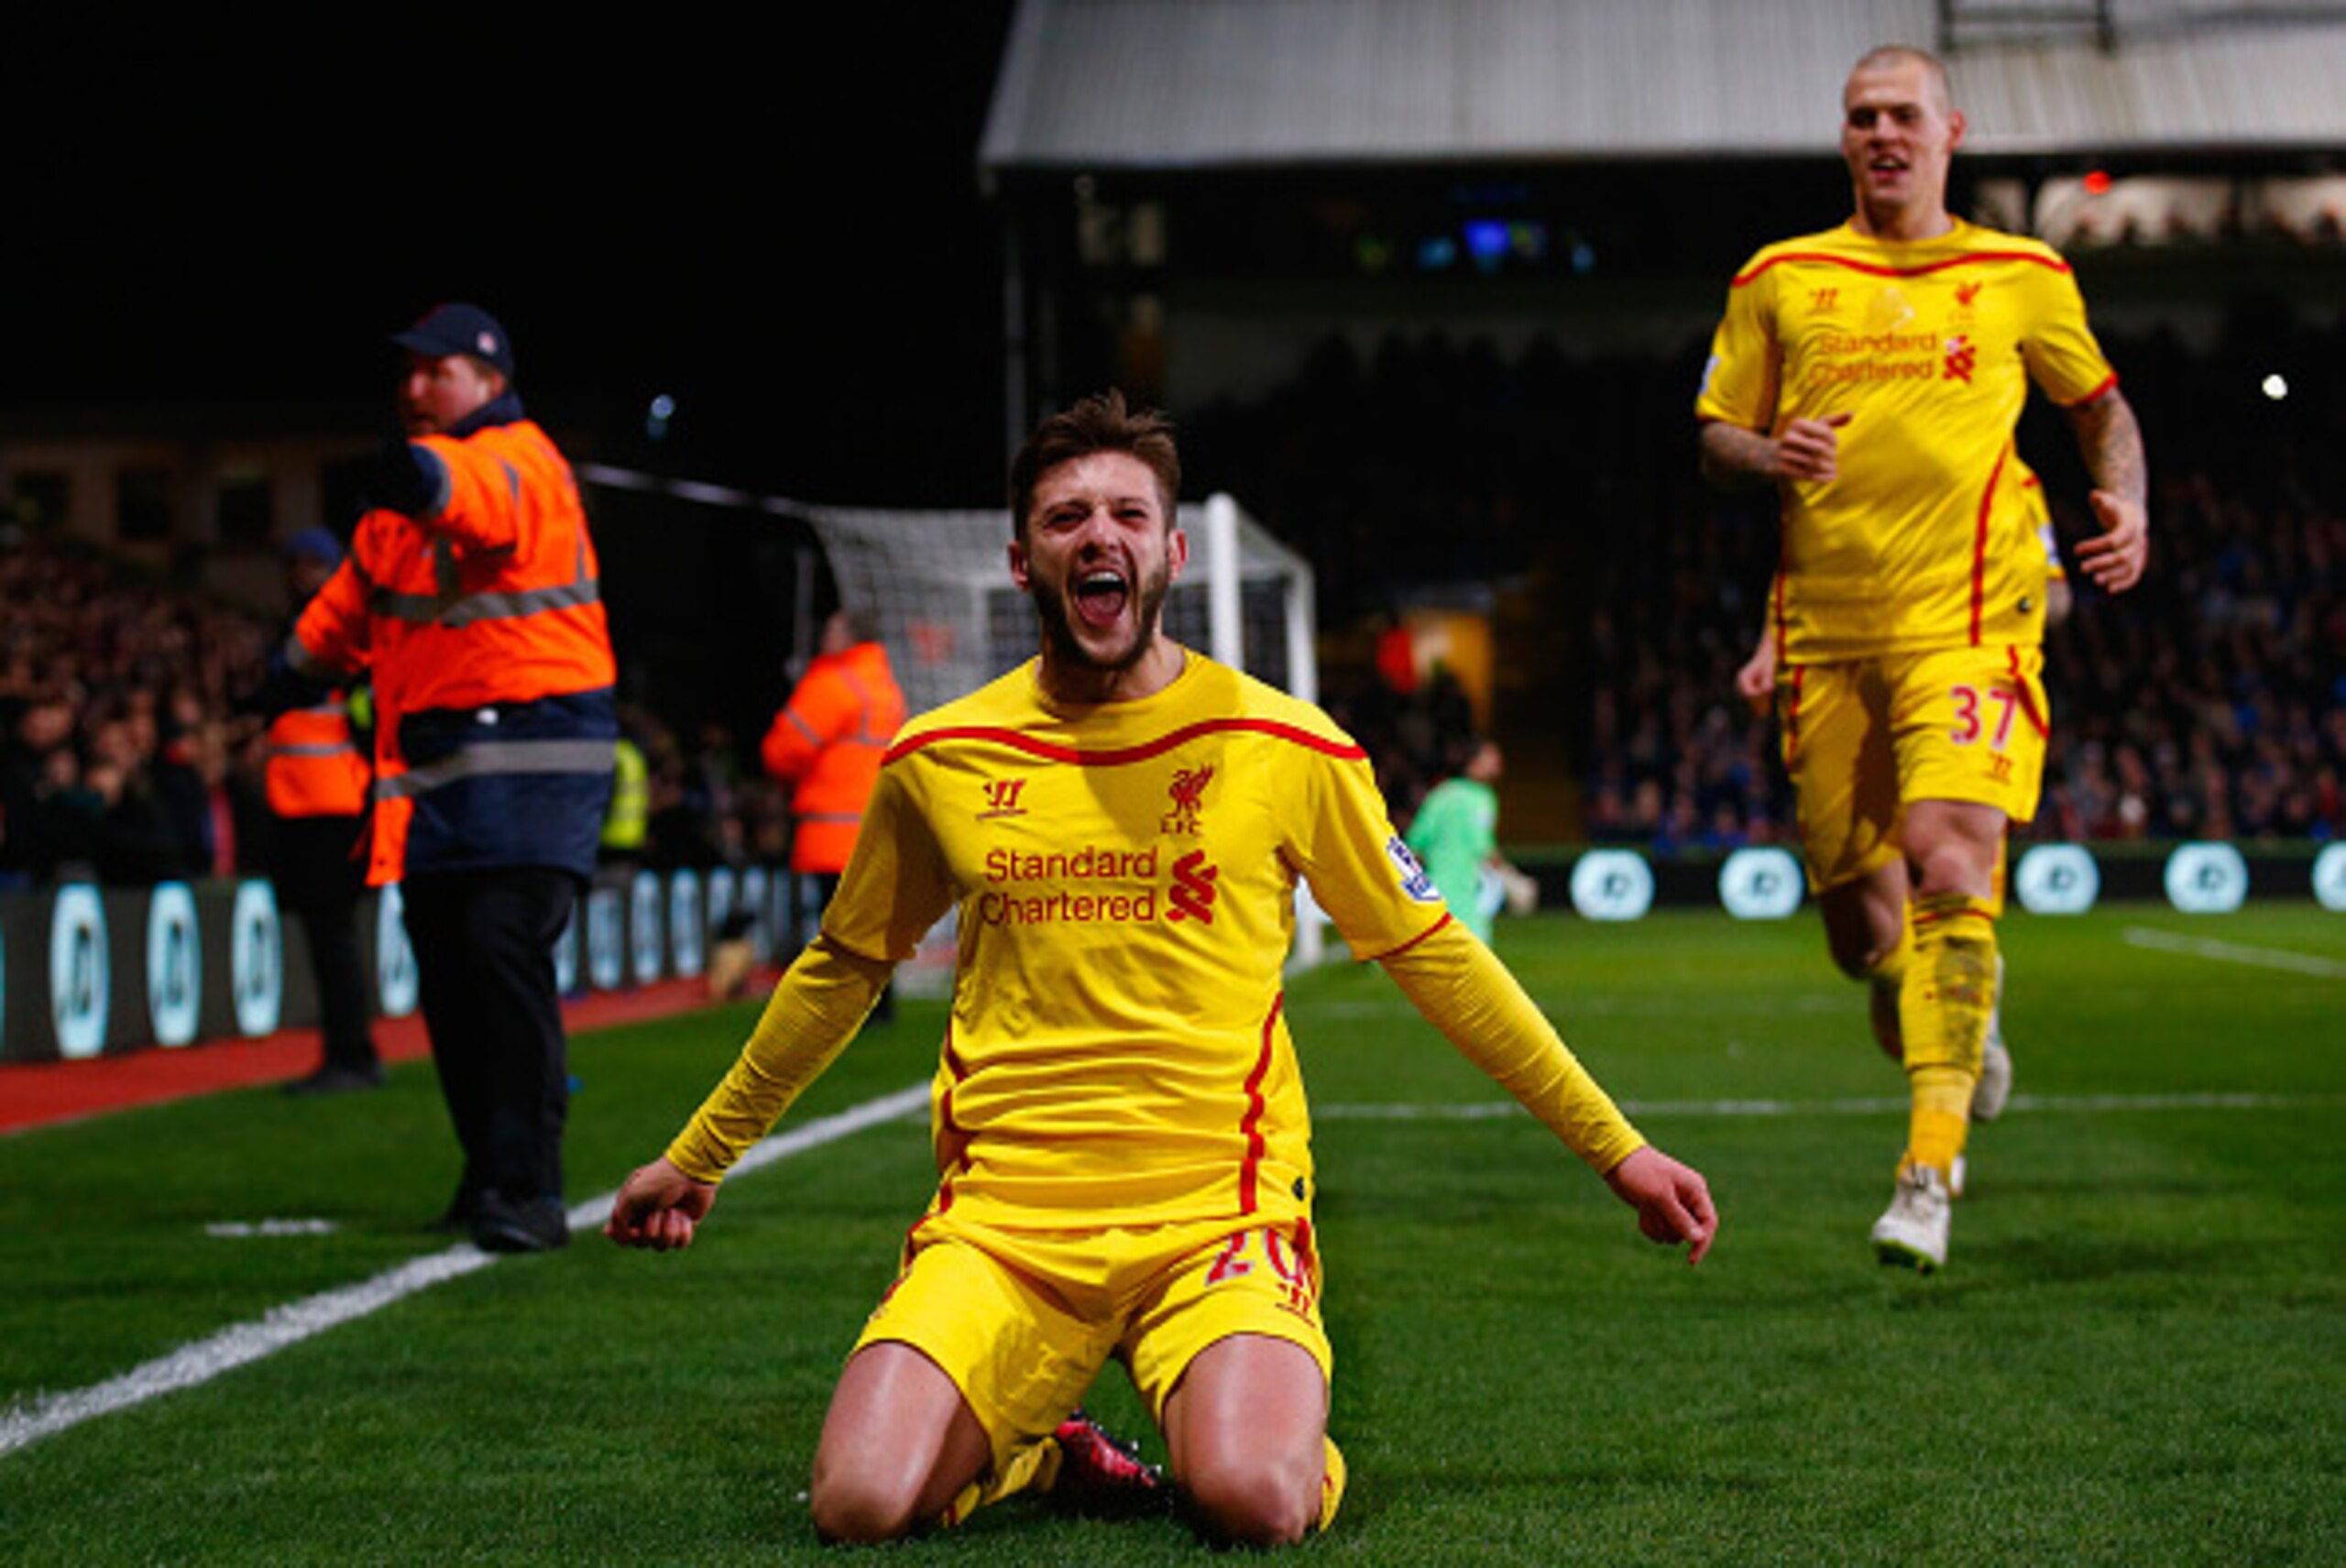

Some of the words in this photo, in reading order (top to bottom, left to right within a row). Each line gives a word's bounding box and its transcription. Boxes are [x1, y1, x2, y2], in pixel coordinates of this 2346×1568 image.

[1950, 685, 2017, 751] 37
[985, 845, 1157, 883] Standard
[979, 886, 1156, 926] Chartered
